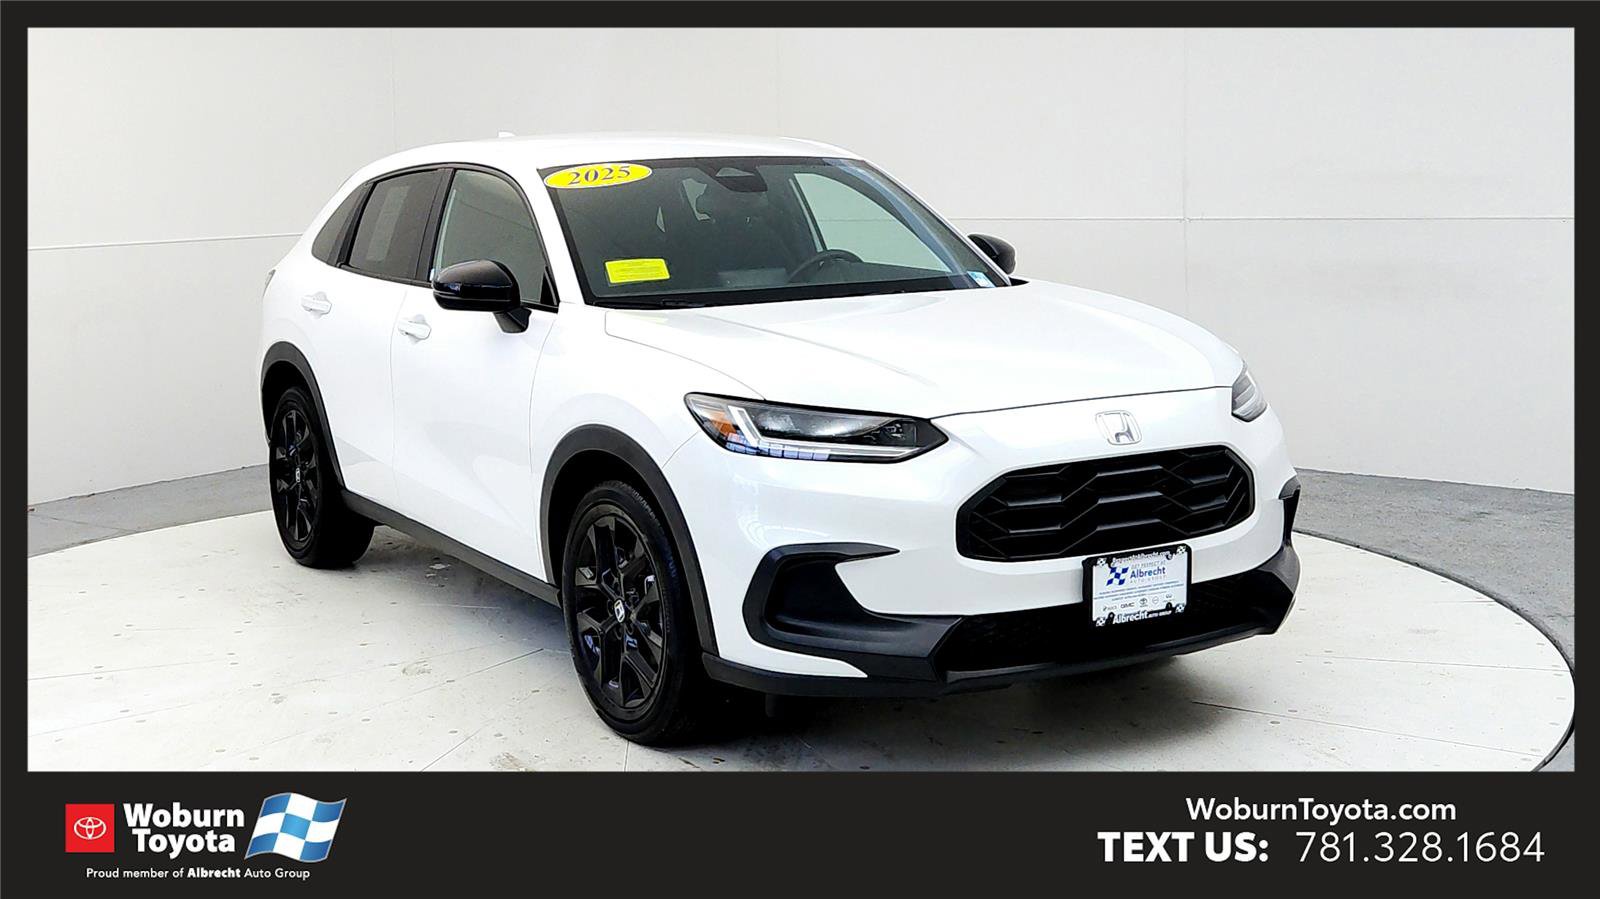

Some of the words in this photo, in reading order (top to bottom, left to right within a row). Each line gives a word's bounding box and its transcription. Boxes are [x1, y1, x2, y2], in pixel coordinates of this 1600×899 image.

[568, 164, 632, 186] 2025
[1130, 566, 1166, 579] Albrecht
[1113, 610, 1149, 624] Albrecht
